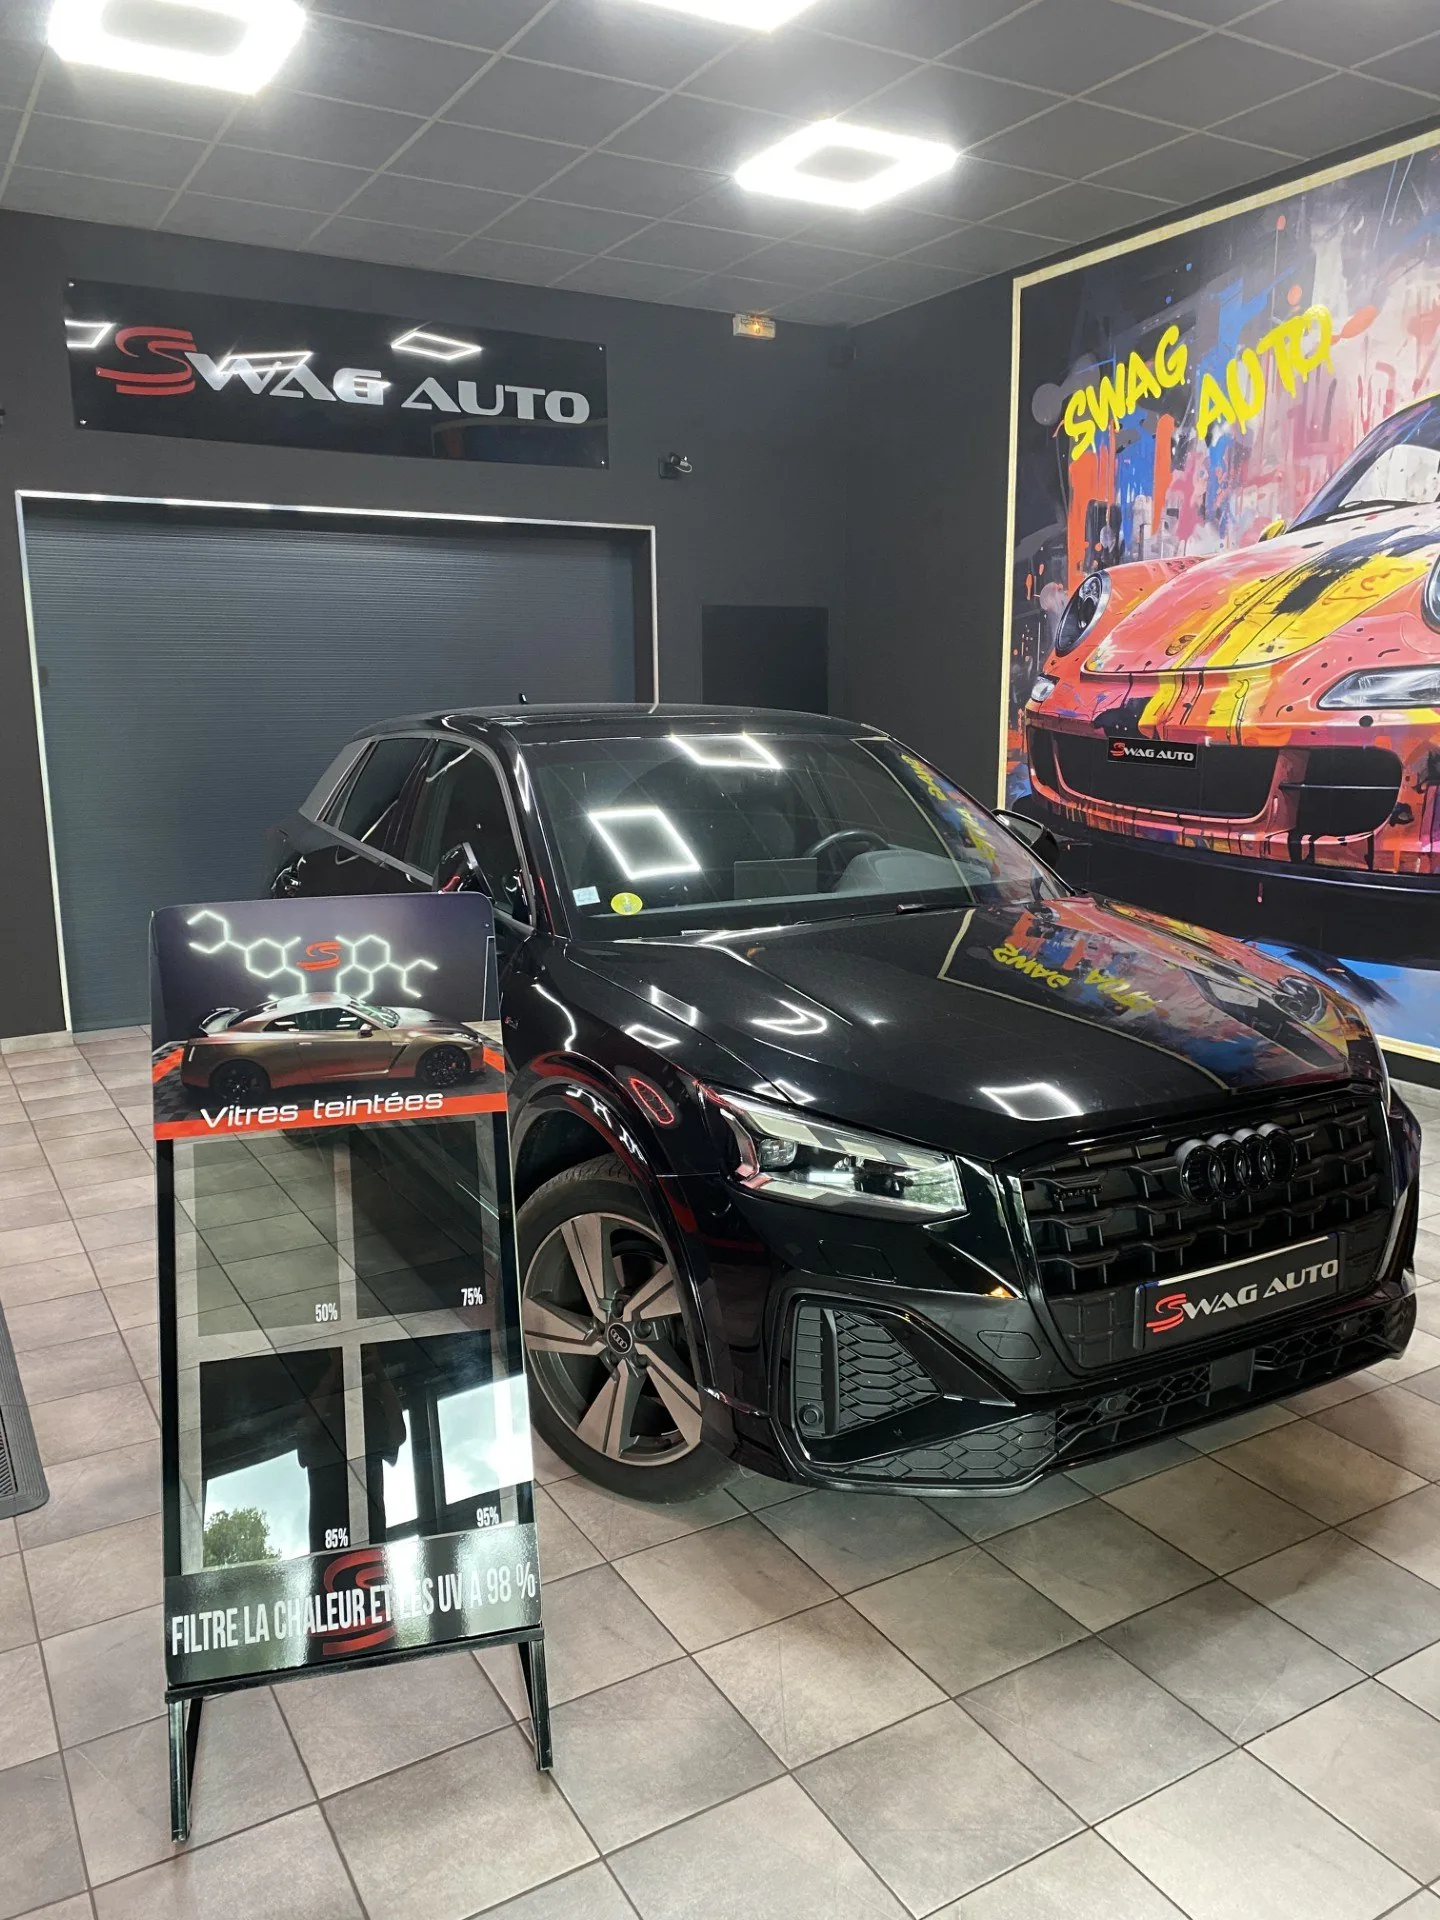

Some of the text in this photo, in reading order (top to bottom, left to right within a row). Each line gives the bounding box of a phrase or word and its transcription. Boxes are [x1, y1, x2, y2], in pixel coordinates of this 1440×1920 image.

[95, 326, 590, 424] SWAG AUTO
[1064, 304, 1333, 460] SWAG AUTO
[1110, 742, 1194, 762] SWAG AUTO
[200, 1091, 443, 1128] Vitres teintées
[461, 1287, 483, 1306] 75%
[1146, 1259, 1339, 1333] SWAG AUTO
[315, 1303, 338, 1322] 50%
[476, 1506, 500, 1527] 95%
[325, 1527, 349, 1549] 85%
[172, 1607, 239, 1656] FILTRE
[243, 1603, 270, 1645] LA
[274, 1588, 366, 1640] CHALEUR
[370, 1584, 392, 1624] ET
[438, 1573, 463, 1613] UV
[486, 1565, 512, 1605] 98
[515, 1561, 536, 1600] %
